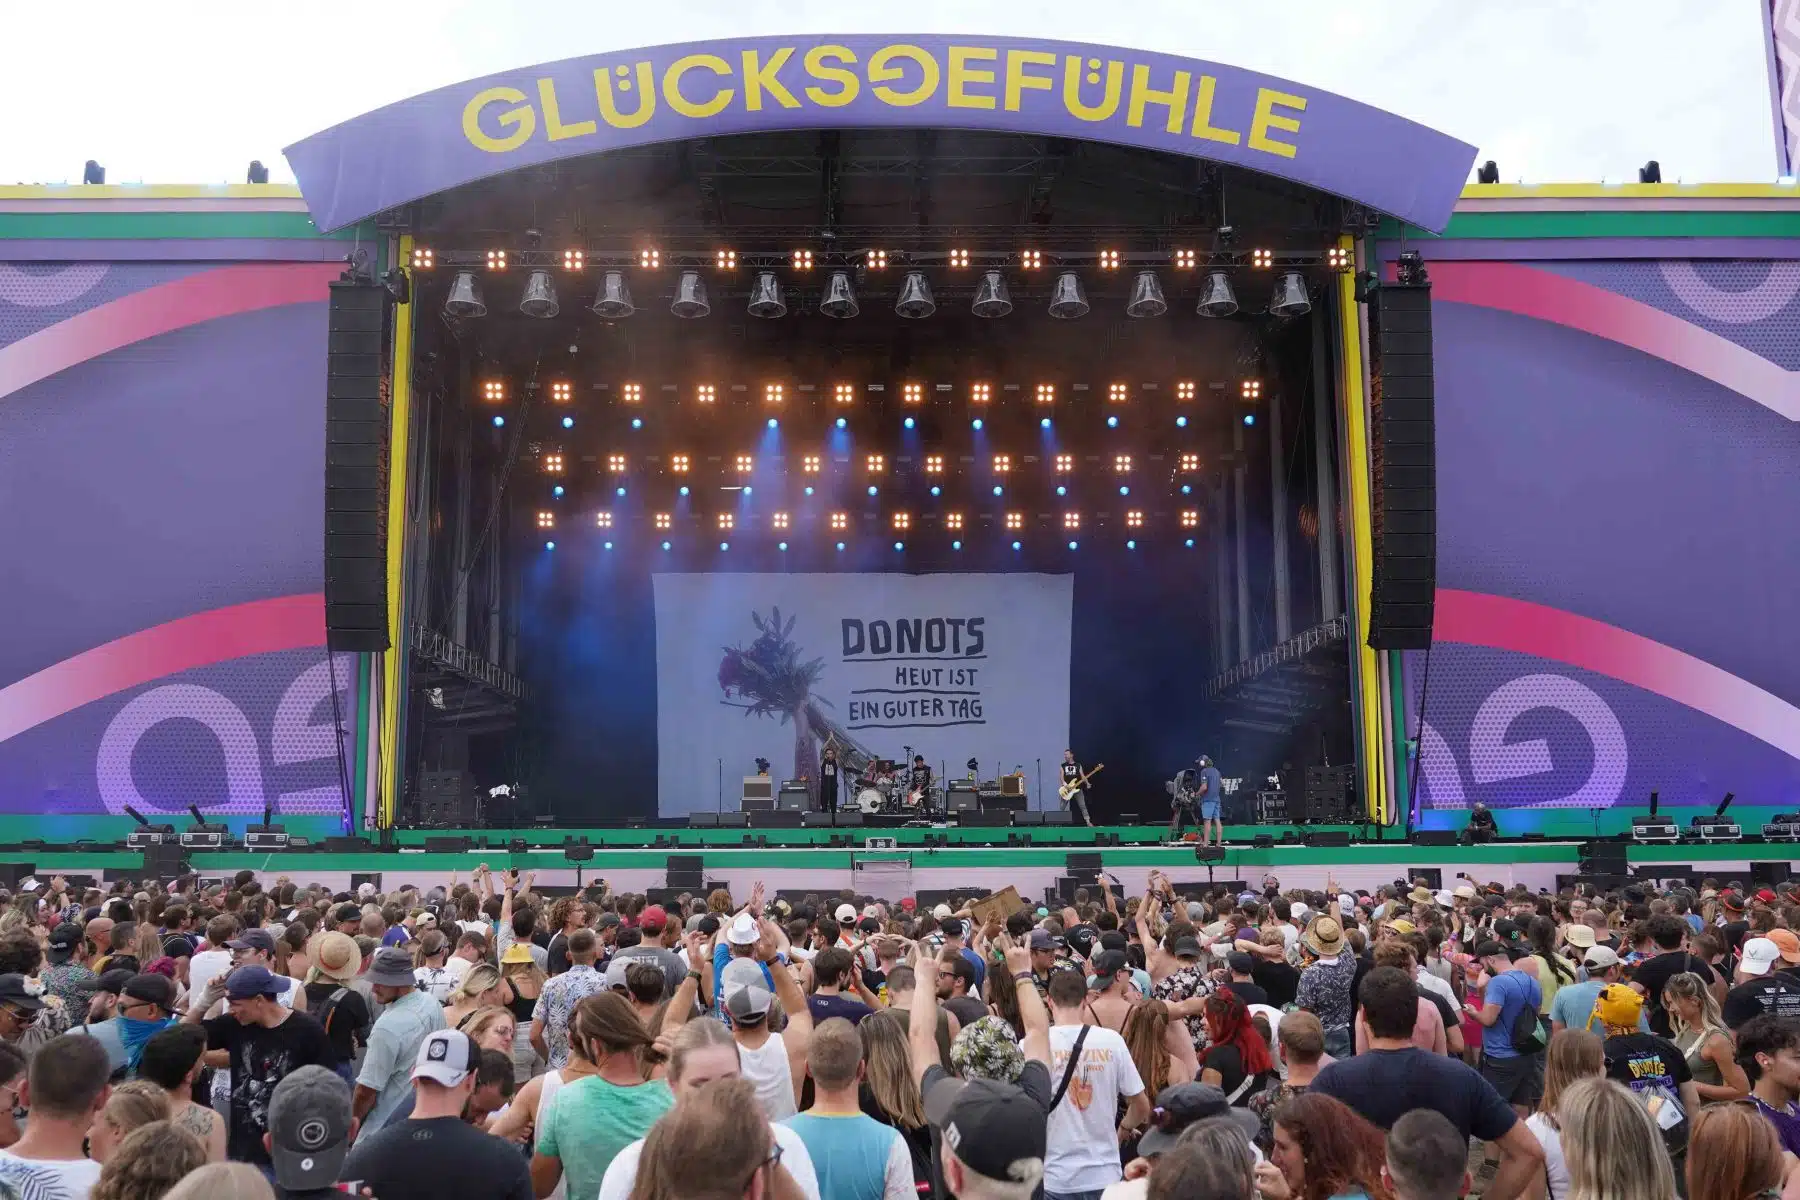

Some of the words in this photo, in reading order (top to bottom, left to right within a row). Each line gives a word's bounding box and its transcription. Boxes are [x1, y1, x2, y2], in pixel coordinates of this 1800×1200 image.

[462, 44, 1308, 159] GLÜCKSGEFÜHLE
[841, 617, 985, 656] DONOTS
[895, 666, 944, 687] HEUT
[949, 668, 978, 686] IST
[849, 701, 879, 721] EIN
[883, 698, 944, 719] GUTER
[948, 698, 982, 719] TAG
